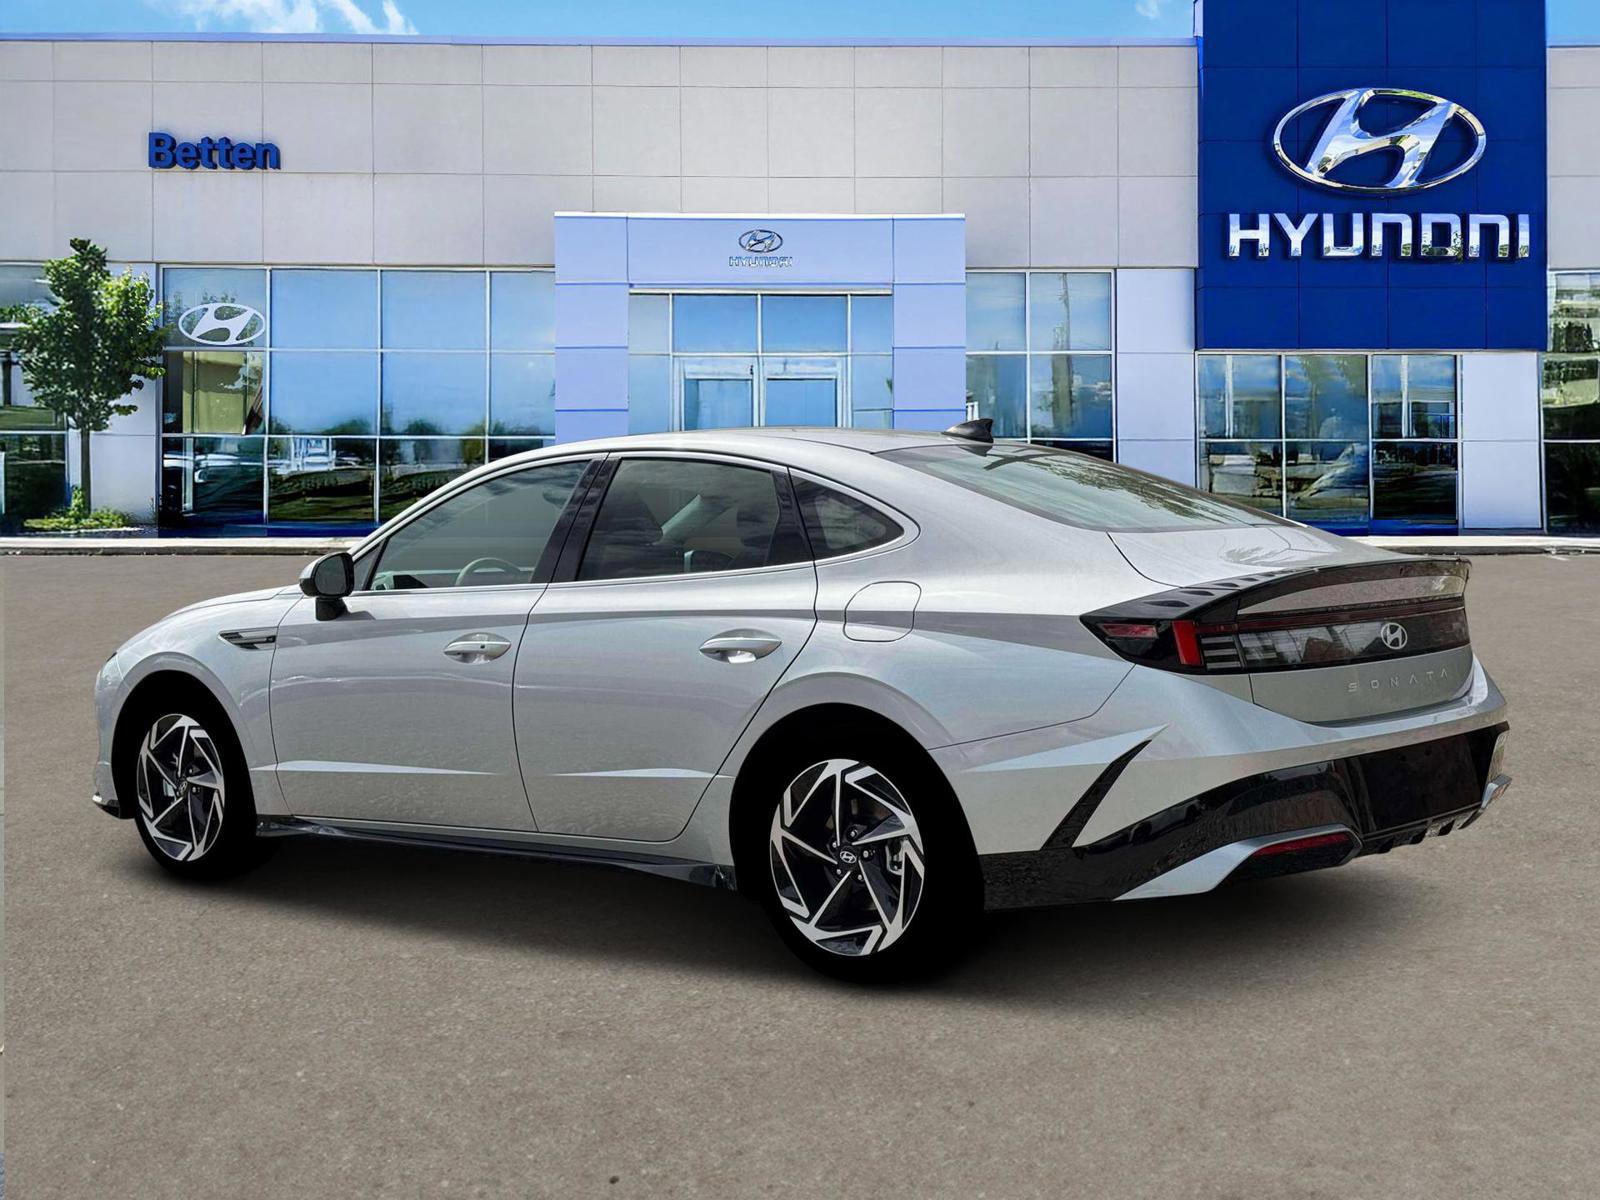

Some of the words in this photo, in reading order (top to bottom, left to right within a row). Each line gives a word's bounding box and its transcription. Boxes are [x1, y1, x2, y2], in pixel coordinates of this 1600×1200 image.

[149, 132, 281, 170] Betten
[1228, 213, 1530, 258] HYUNDAI
[729, 256, 793, 268] HYUNDAI
[1348, 668, 1448, 692] SONATA
